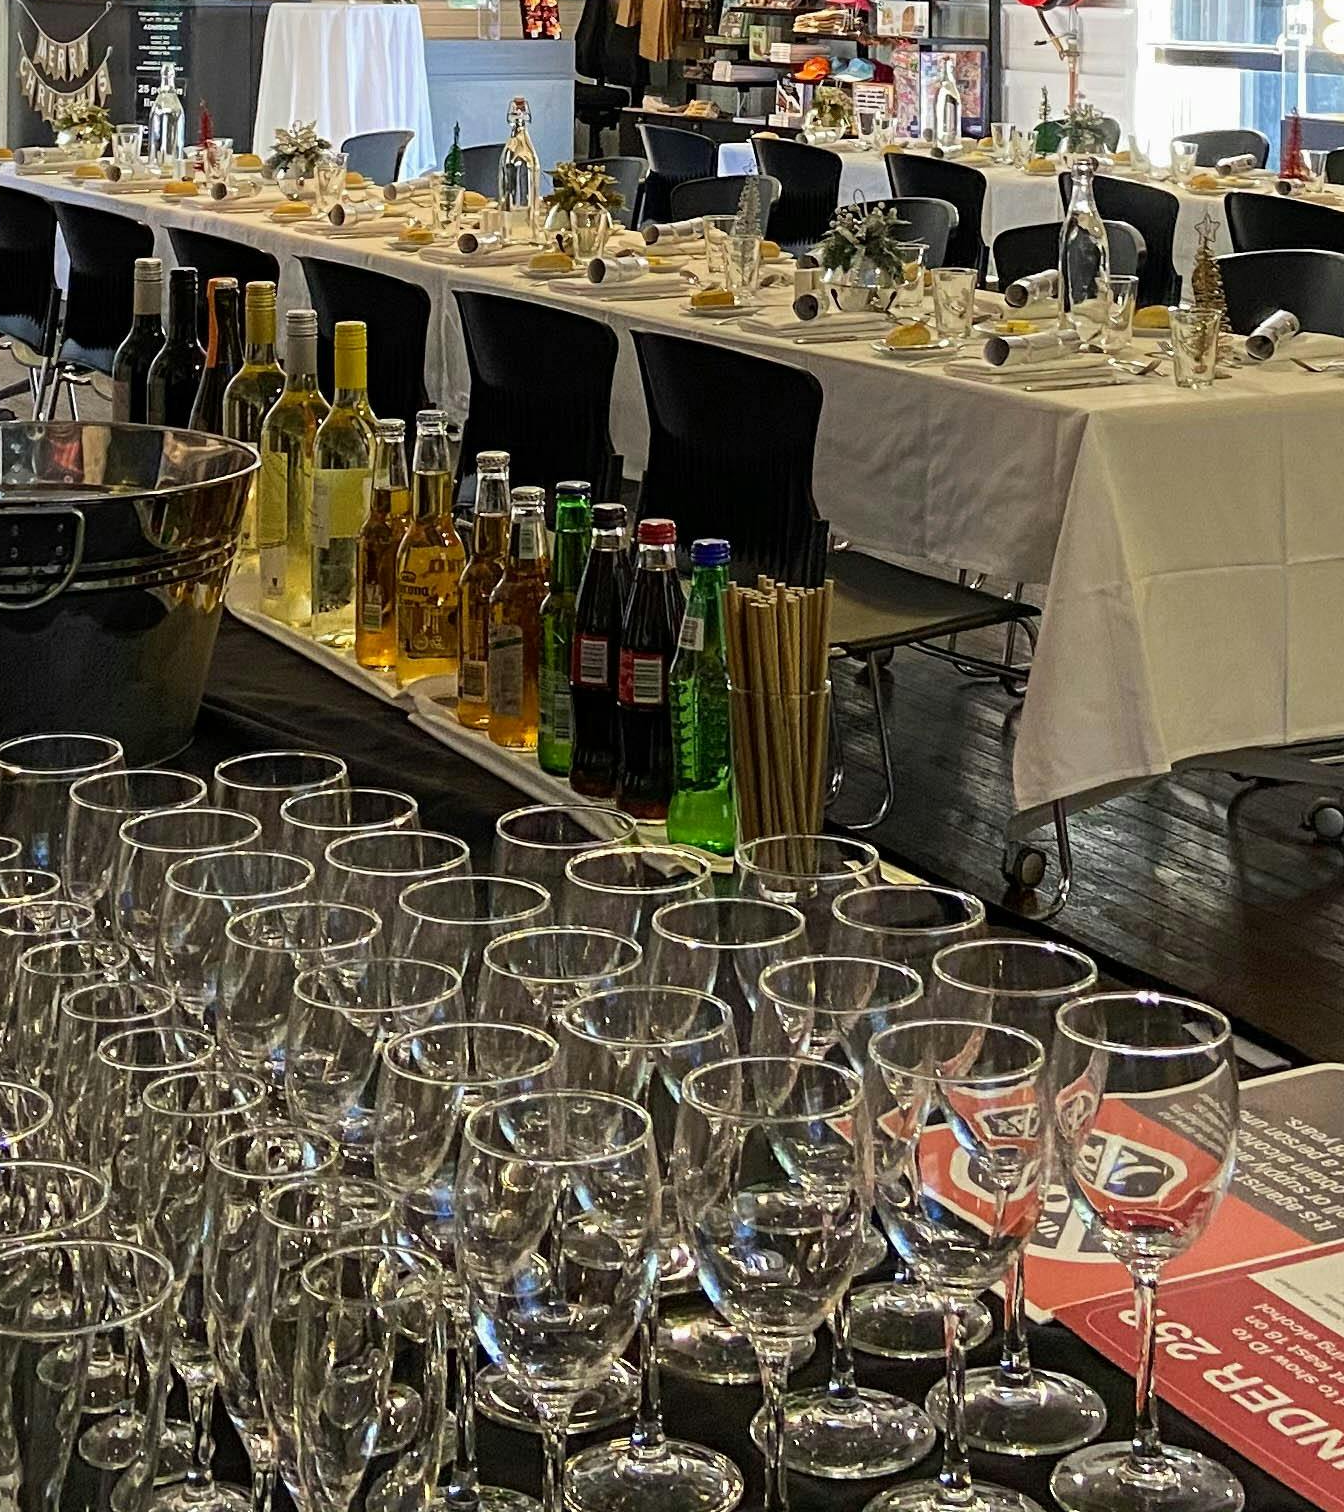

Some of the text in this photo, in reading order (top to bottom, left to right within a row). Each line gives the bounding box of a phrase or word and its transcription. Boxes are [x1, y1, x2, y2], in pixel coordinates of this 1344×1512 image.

[38, 36, 88, 71] MERRY
[1263, 1127, 1331, 1159] person
[1285, 1116, 1341, 1146] years.
[1236, 1129, 1295, 1163] alcoho
[1321, 1159, 1339, 1167] a
[1248, 1162, 1311, 1193] supply
[1234, 1174, 1337, 1231] It is against
[1303, 1194, 1331, 1205] or
[1232, 1328, 1253, 1340] to
[1245, 1315, 1269, 1330] on
[1253, 1303, 1318, 1340] alcohol
[1249, 1341, 1274, 1354] ID
[1264, 1331, 1288, 1344] 18
[1270, 1355, 1319, 1384] show
[1287, 1344, 1333, 1372] least
[1318, 1384, 1339, 1397] to
